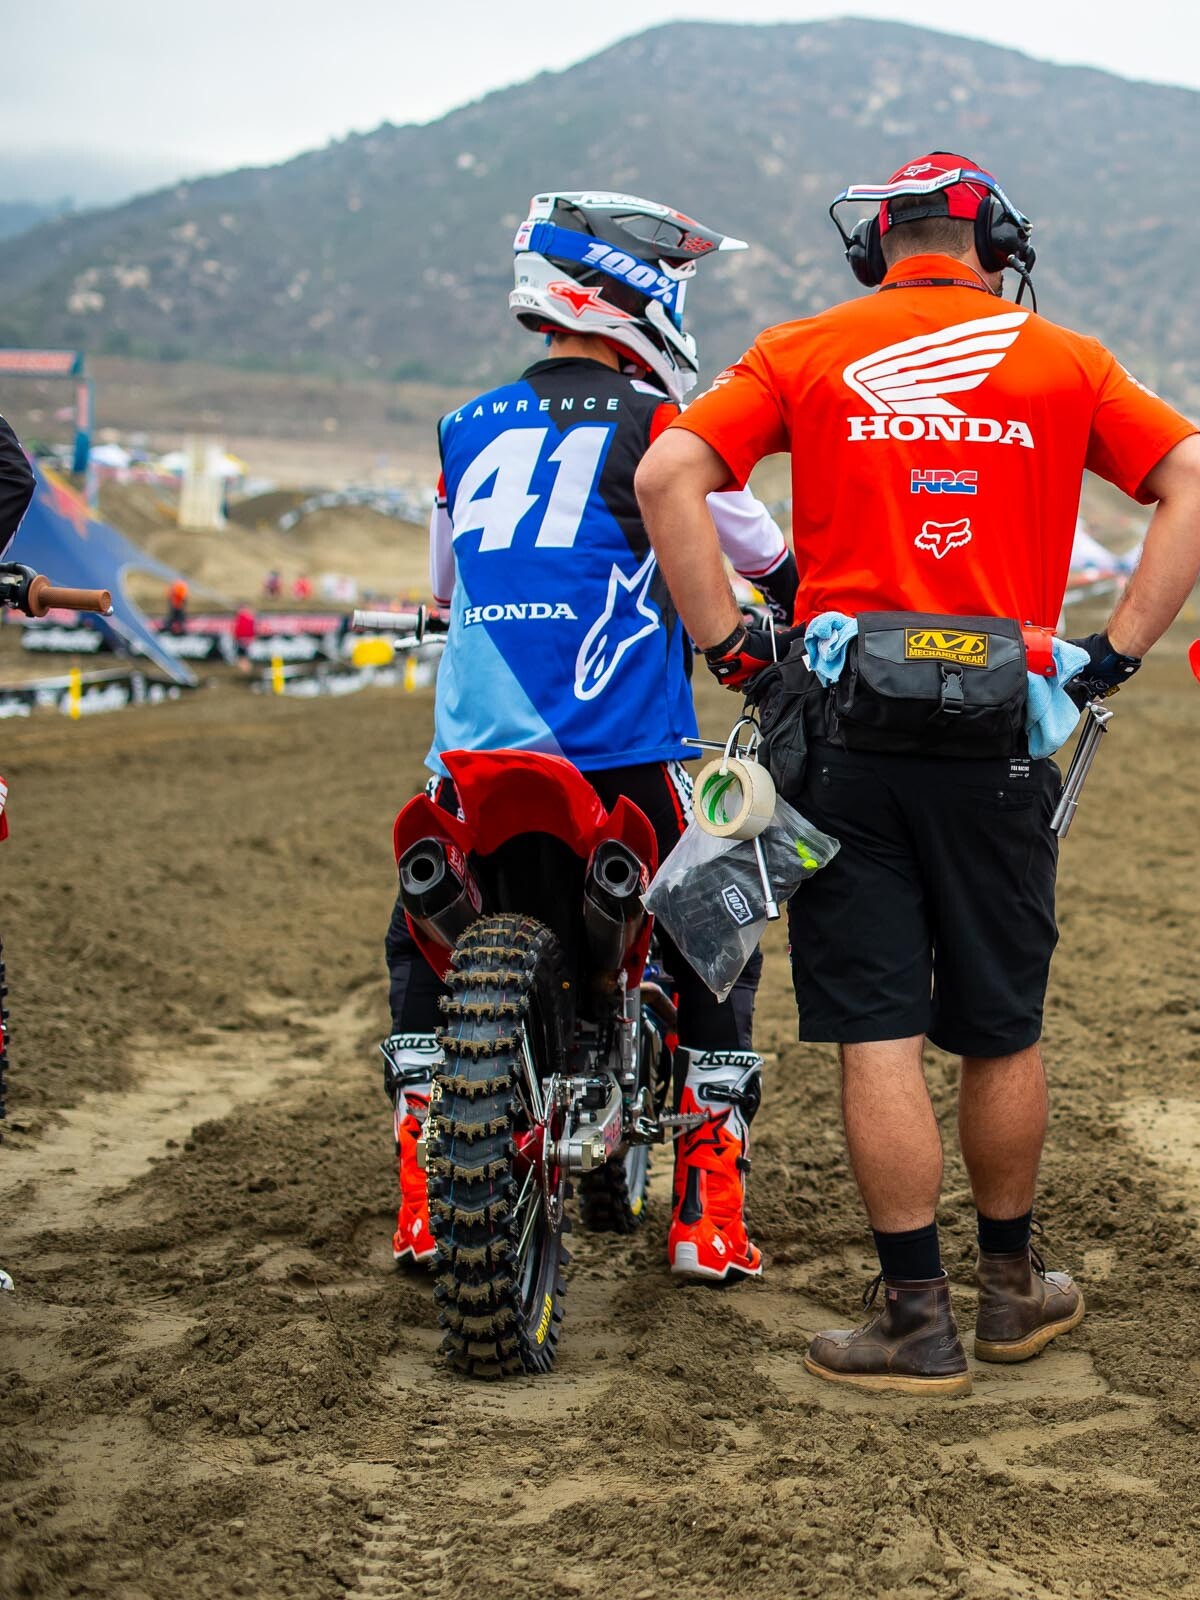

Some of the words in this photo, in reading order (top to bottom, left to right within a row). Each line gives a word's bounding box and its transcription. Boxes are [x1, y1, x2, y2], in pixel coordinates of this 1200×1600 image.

[582, 243, 676, 304] 100%
[896, 279, 933, 287] HONDA
[454, 398, 619, 423] LAWRENCE
[847, 416, 1035, 449] HONDA
[451, 427, 610, 553] 41
[911, 469, 978, 495] HRC
[463, 602, 578, 627] HONDA
[908, 648, 957, 660] MECHANIX
[958, 654, 984, 664] WEAR
[726, 891, 748, 919] 100%
[692, 1049, 760, 1070] Astars
